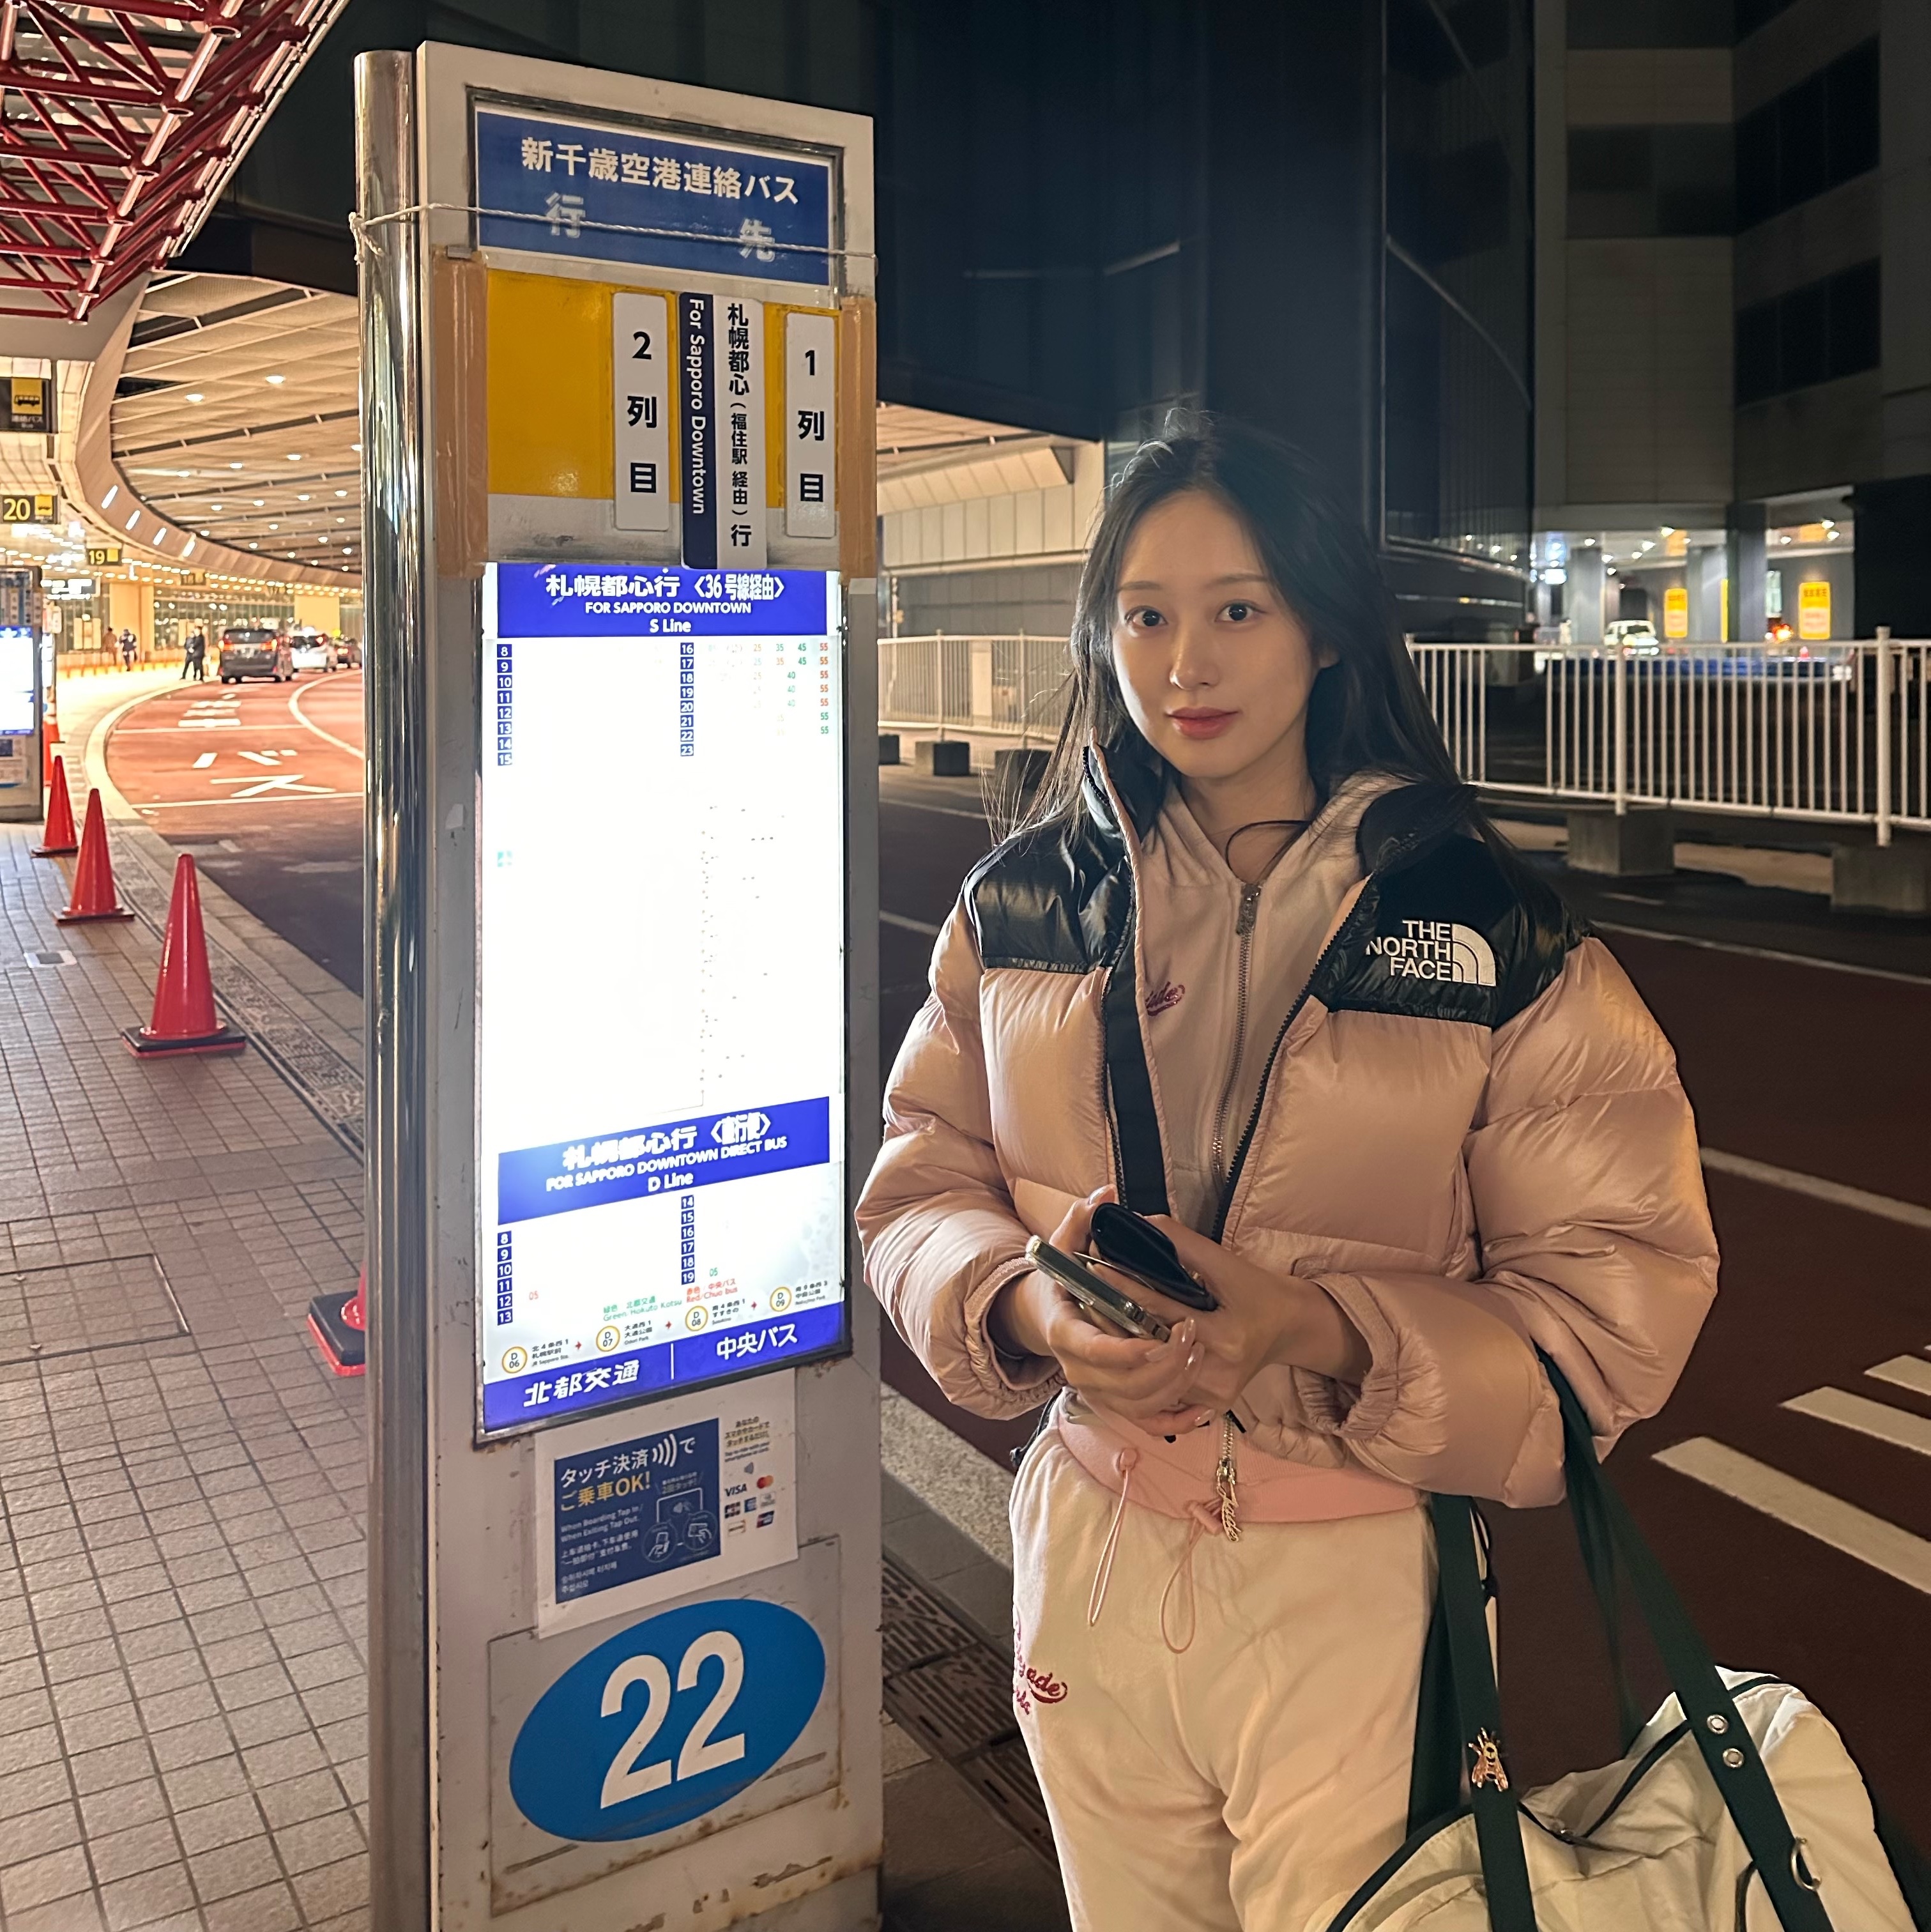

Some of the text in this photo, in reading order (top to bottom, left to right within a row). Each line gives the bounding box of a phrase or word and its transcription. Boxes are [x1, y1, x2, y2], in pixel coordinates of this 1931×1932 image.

[521, 137, 798, 205] 新千歳空港連絡バス
[686, 298, 706, 515] For Sapporo Downtown
[3, 498, 31, 521] 20
[89, 550, 105, 565] 19
[546, 574, 681, 597] 札幌都心行
[585, 601, 752, 614] FOR SAPPORO DOWNTOWN
[650, 618, 692, 633] S Line
[501, 647, 508, 657] 8
[682, 644, 694, 655] 16
[798, 643, 806, 651] 45
[820, 643, 828, 651] 55
[501, 662, 508, 672] 9
[682, 659, 694, 669] 17
[798, 657, 807, 665] 45
[820, 657, 828, 665] 55
[500, 677, 512, 687] 10
[682, 673, 694, 683] 18
[500, 692, 510, 703] 11
[682, 687, 694, 698] 19
[681, 702, 693, 712] 20
[500, 708, 512, 719] 12
[681, 716, 692, 727] 21
[821, 712, 829, 721] 55
[500, 723, 512, 734] 13
[681, 731, 693, 742] 22
[821, 726, 829, 735] 55
[500, 739, 512, 750] 14
[681, 746, 694, 756] 23
[500, 754, 512, 765] 15
[1402, 919, 1451, 942] THE
[1365, 937, 1451, 962] NORTH
[1389, 956, 1451, 981] FACE
[637, 1148, 719, 1175] DOWNTOWN
[764, 1136, 788, 1151] BUS
[648, 1172, 694, 1193] D Line
[682, 1197, 694, 1208] 14
[682, 1211, 694, 1223] 15
[682, 1227, 694, 1238] 16
[501, 1233, 508, 1245] 8
[682, 1241, 694, 1253] 17
[501, 1249, 508, 1261] 9
[682, 1257, 694, 1268] 18
[499, 1264, 512, 1276] 10
[682, 1271, 694, 1284] 19
[499, 1280, 510, 1292] 11
[500, 1296, 512, 1308] 12
[500, 1311, 512, 1324] 13
[603, 1338, 613, 1347] 07
[716, 1323, 798, 1361] 中央バス
[511, 1353, 517, 1361] D
[509, 1360, 520, 1368] 06
[523, 1359, 640, 1407] 北都交通
[561, 1448, 649, 1489] タッチ決済
[560, 1471, 652, 1512] ご乗車OK!
[724, 1483, 747, 1497] VISA
[600, 1630, 745, 1810] 22
